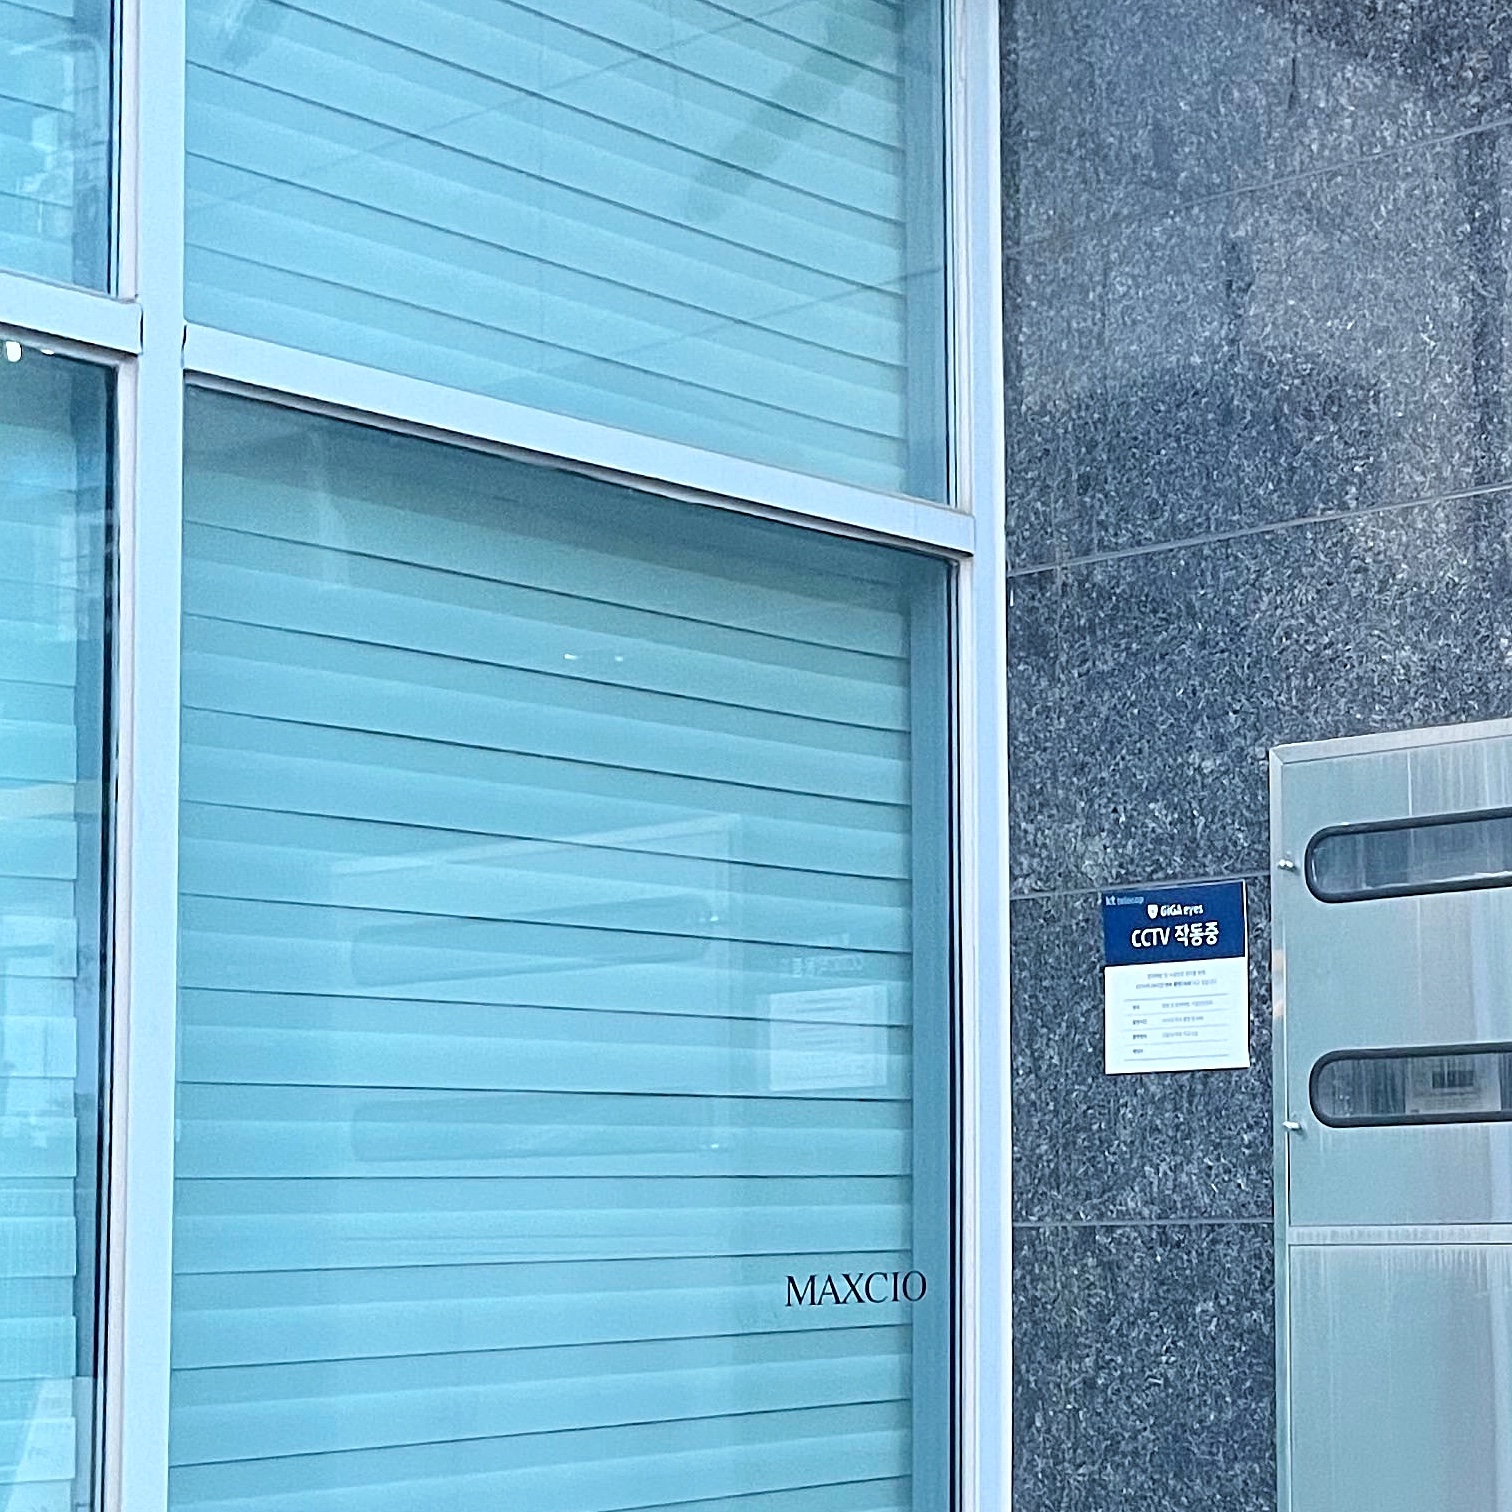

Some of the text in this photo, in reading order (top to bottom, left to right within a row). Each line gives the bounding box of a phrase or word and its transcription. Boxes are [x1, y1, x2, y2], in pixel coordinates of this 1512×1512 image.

[1131, 921, 1219, 947] CCTV 작동중
[785, 1270, 927, 1307] MAXCIO
